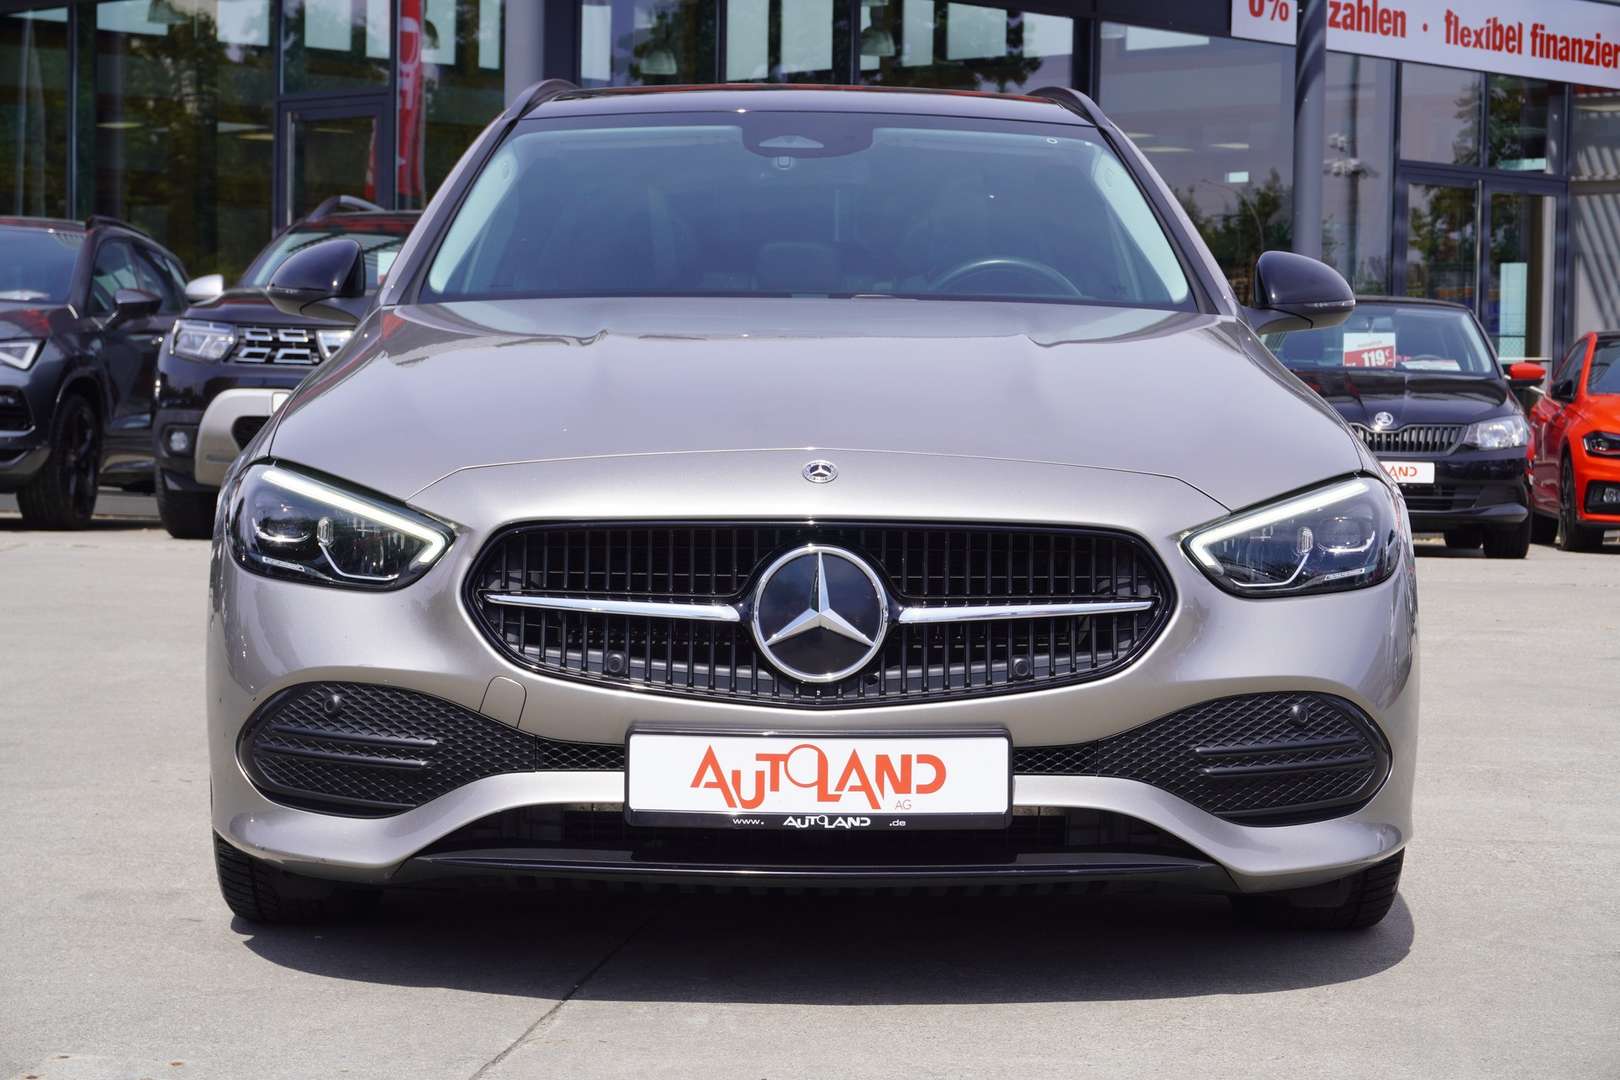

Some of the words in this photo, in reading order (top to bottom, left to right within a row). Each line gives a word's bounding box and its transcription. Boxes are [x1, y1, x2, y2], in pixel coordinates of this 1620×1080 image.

[1444, 9, 1524, 55] flexibel
[1530, 22, 1620, 69] finanzier
[894, 800, 912, 811] AG
[732, 817, 765, 826] www.
[889, 818, 907, 828] .de
